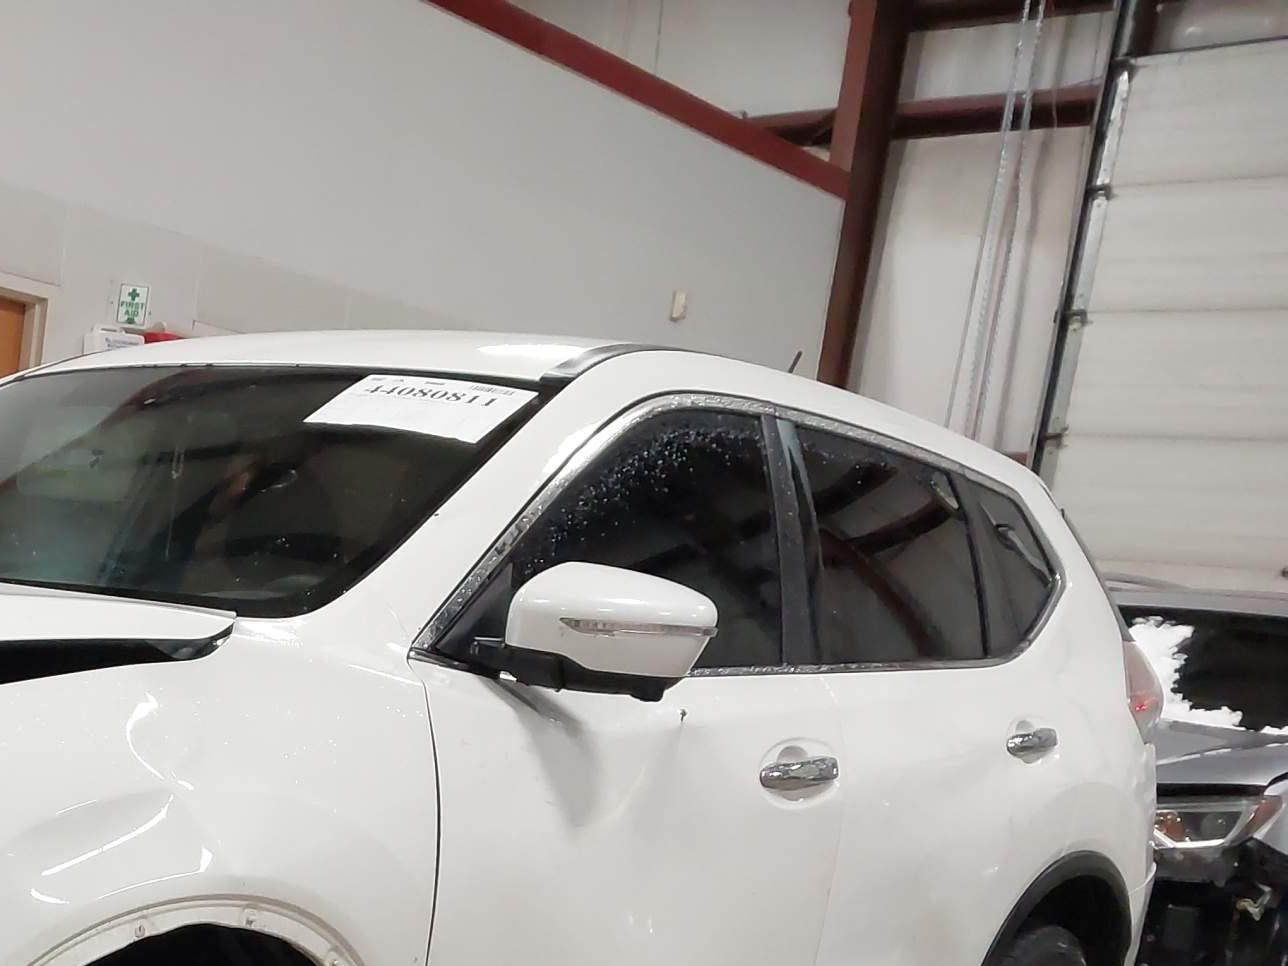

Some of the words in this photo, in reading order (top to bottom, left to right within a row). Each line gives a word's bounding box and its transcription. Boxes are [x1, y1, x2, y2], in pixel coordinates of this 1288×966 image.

[120, 301, 144, 310] FIRST
[124, 309, 139, 317] AID
[365, 384, 497, 406] 44080811
